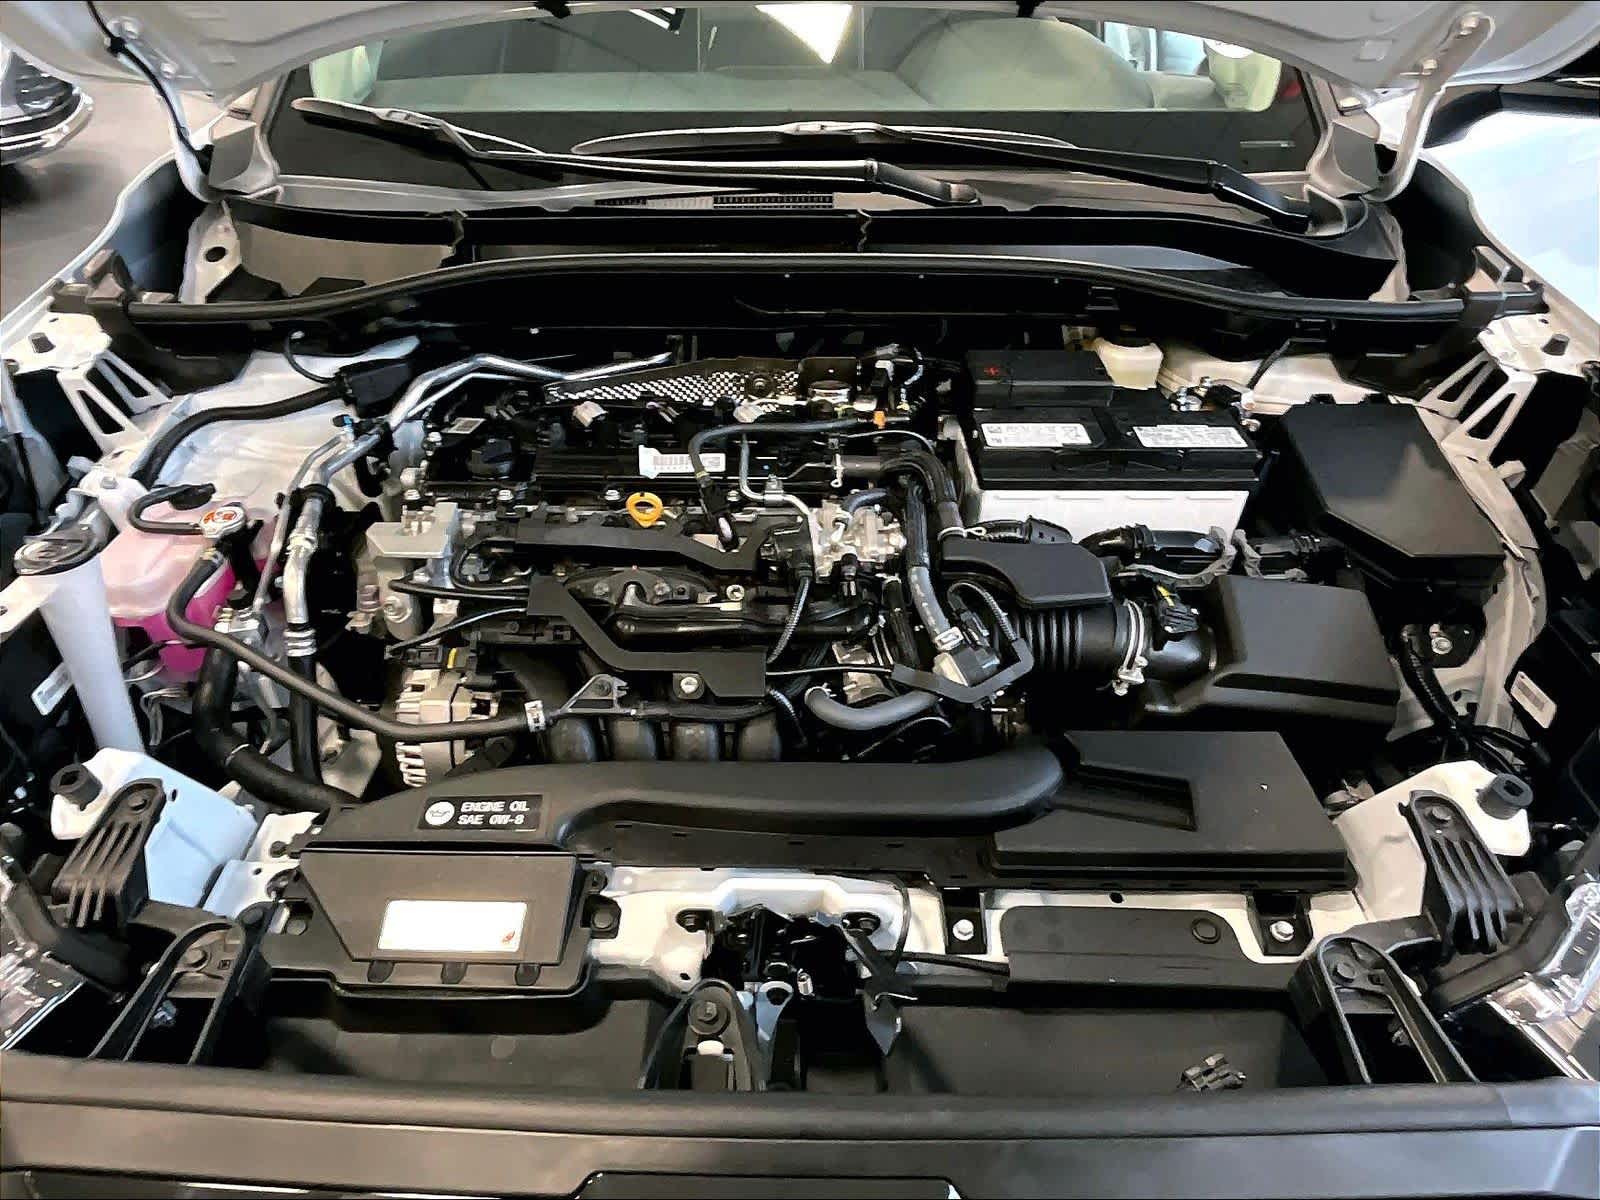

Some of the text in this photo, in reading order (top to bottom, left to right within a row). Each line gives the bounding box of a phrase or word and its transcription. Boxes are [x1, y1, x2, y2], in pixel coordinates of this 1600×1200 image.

[461, 801, 530, 812] ENGINE OIL
[457, 814, 525, 825] SAE 0W-8
